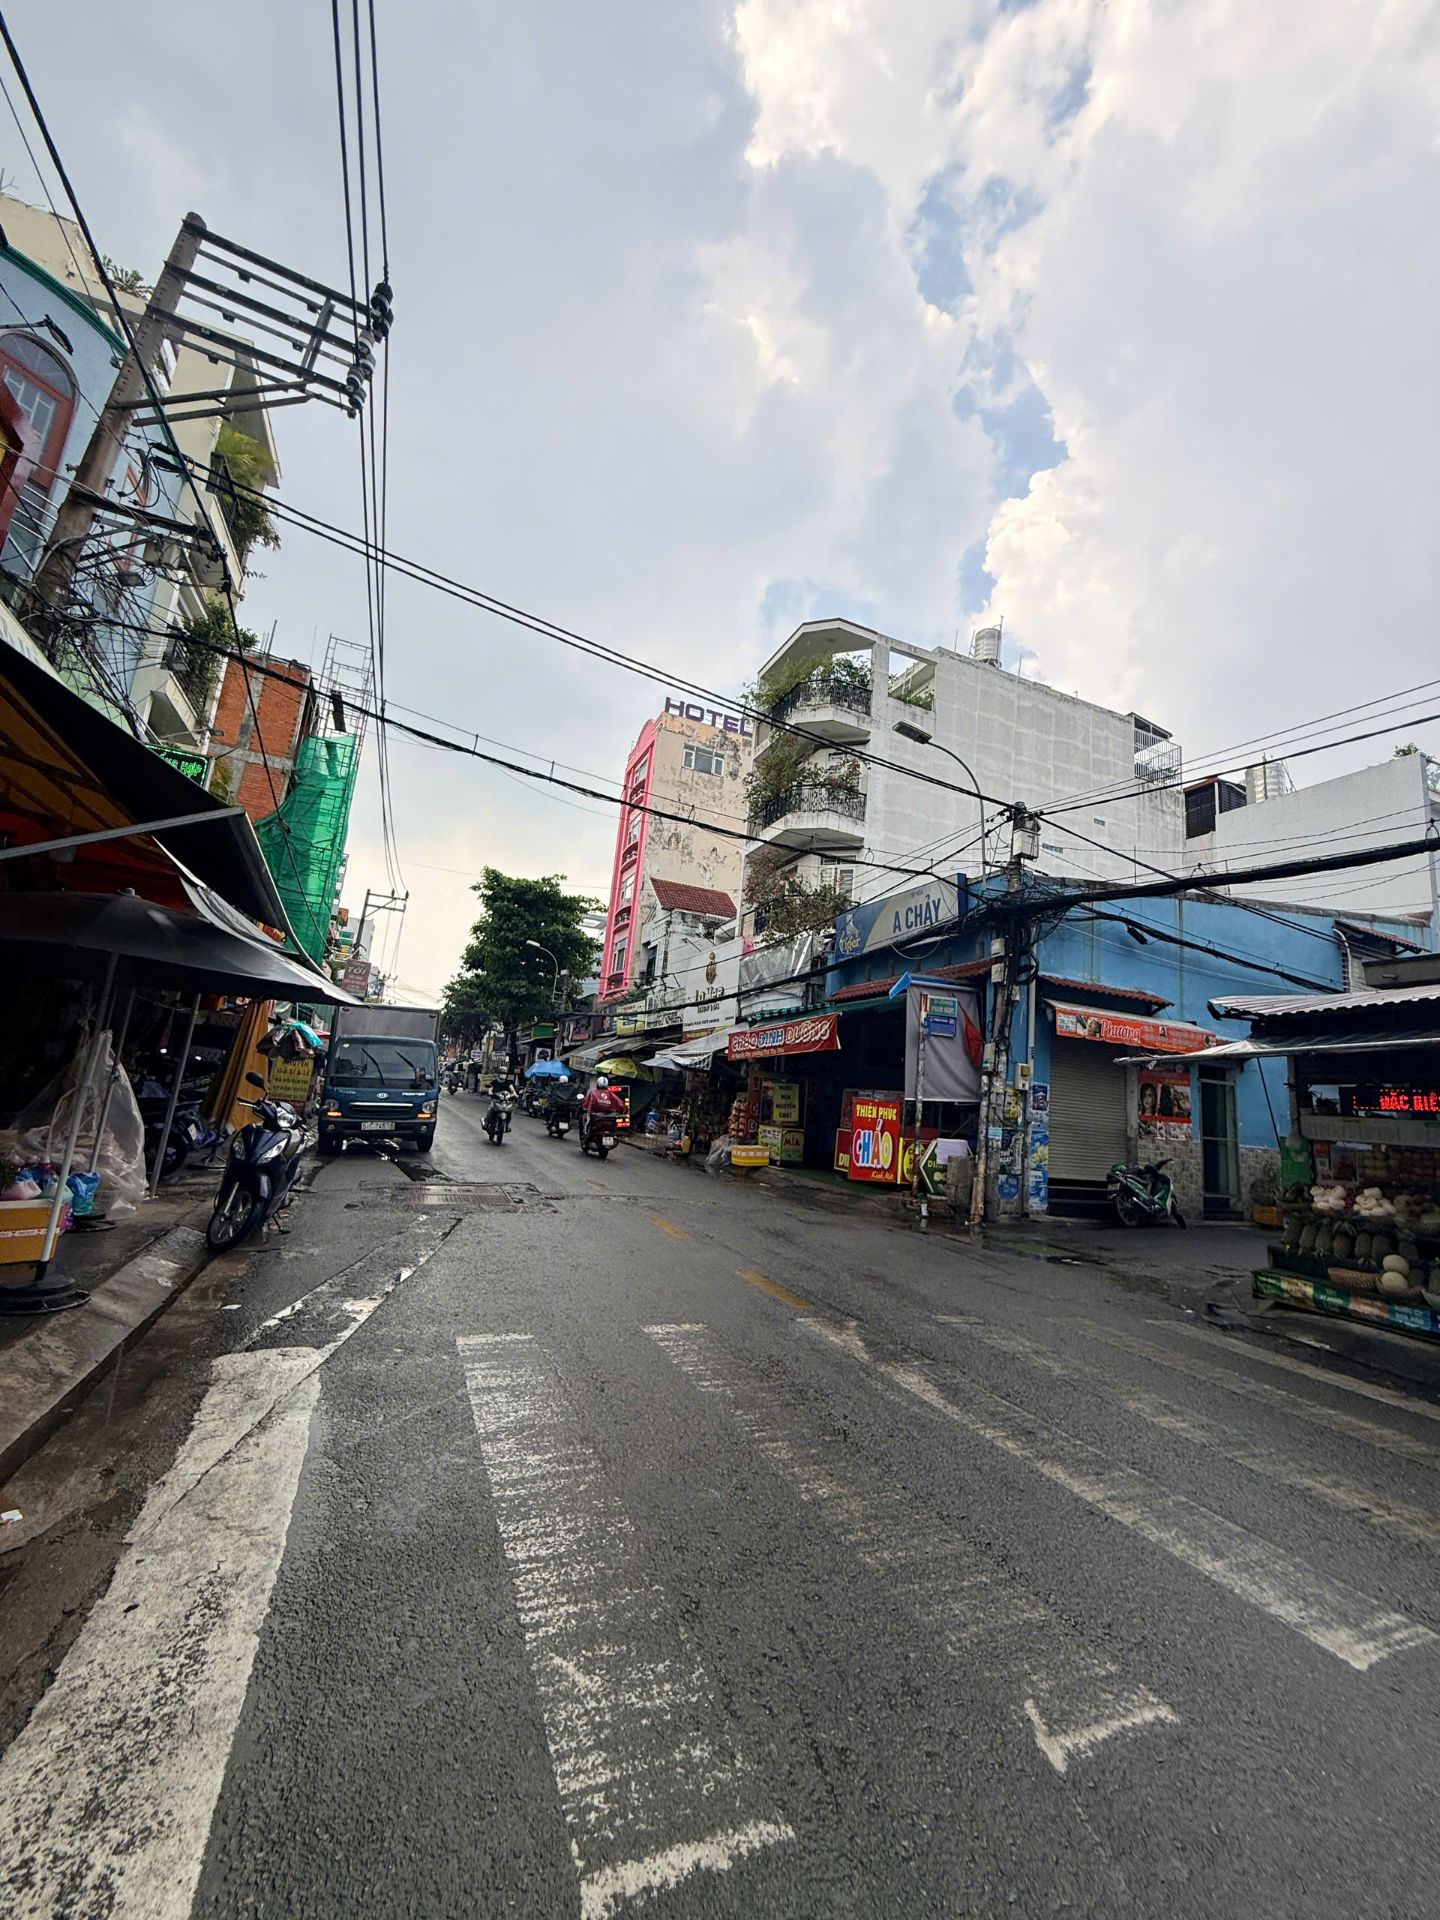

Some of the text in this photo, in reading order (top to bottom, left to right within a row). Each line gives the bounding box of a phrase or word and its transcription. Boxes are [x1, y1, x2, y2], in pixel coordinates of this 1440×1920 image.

[664, 696, 753, 738] HOTEL
[893, 911, 901, 933] A
[852, 1118, 893, 1170] CHÁO
